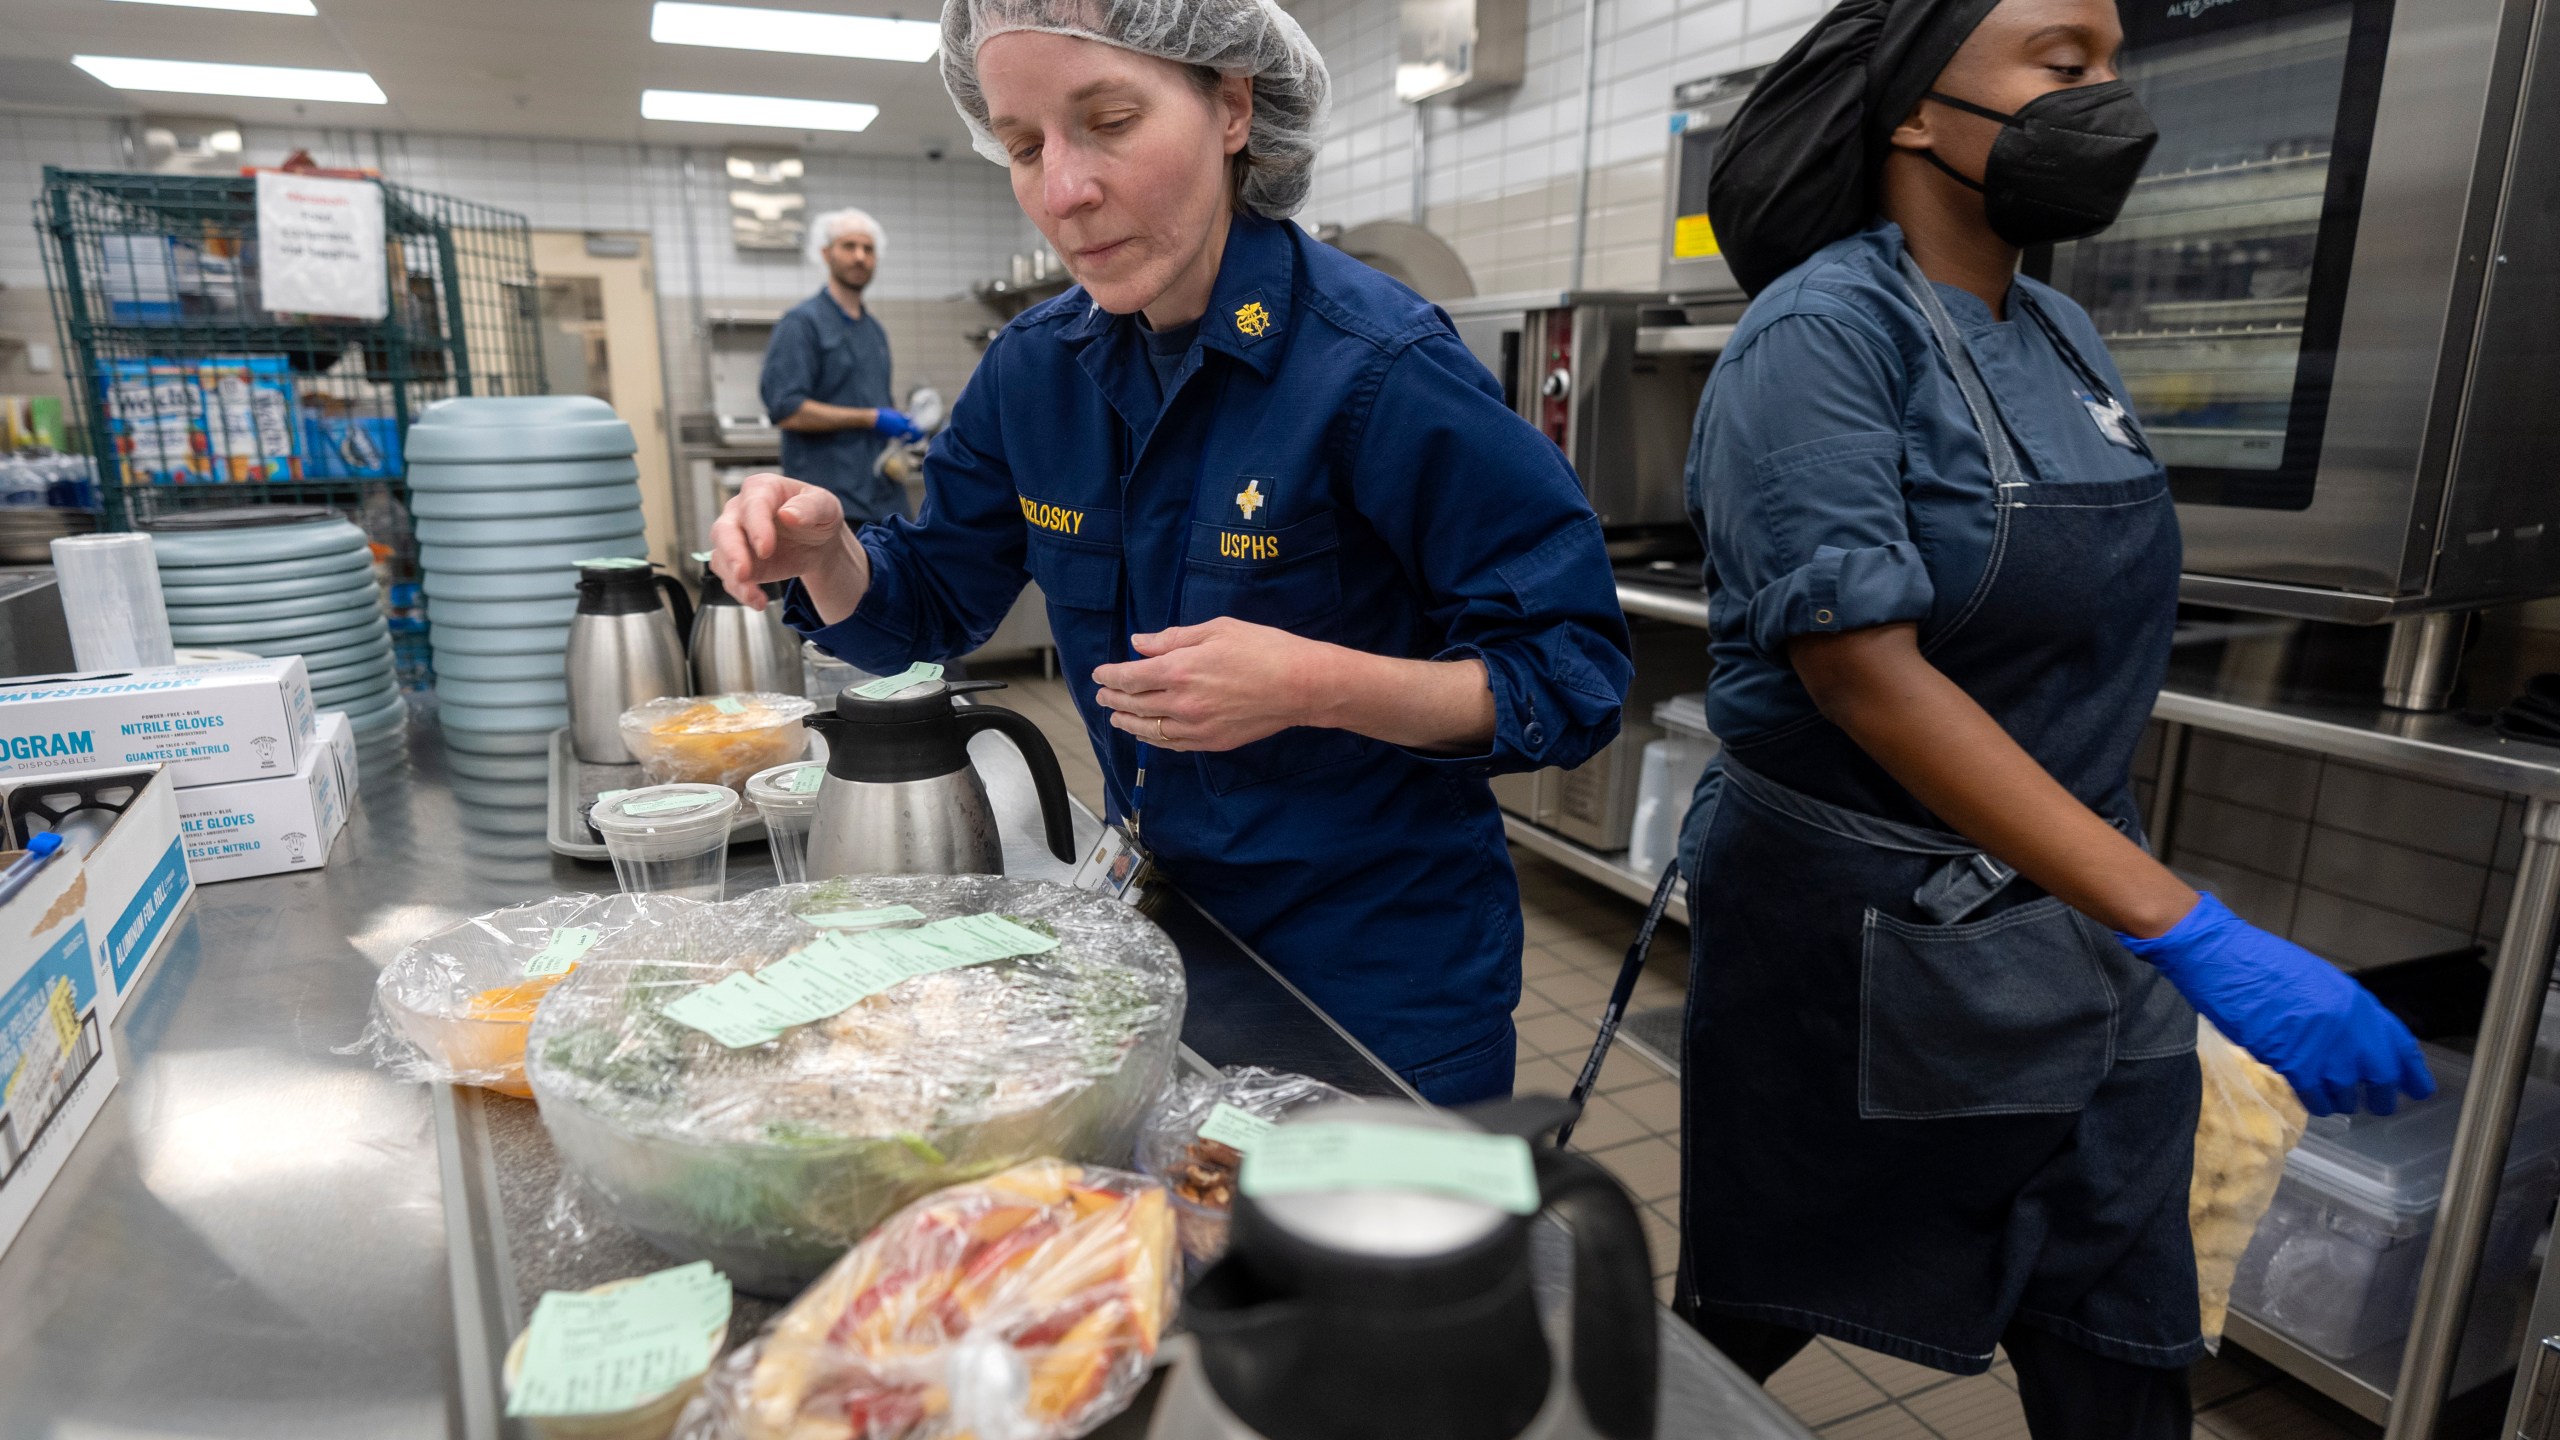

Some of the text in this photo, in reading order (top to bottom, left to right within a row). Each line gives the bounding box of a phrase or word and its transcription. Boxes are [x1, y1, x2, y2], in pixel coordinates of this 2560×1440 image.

[1221, 532, 1280, 560] USPHS
[141, 711, 180, 720] POWDER-FREE
[120, 715, 225, 736] NITRILE GLOVES
[125, 749, 173, 763] GUANTES
[176, 747, 188, 757] DE
[191, 743, 230, 756] NITRILO
[17, 755, 96, 770] DISPOSABLES
[207, 813, 255, 829] GLOVES
[207, 845, 220, 856] DE
[222, 840, 261, 854] NITRILO
[115, 880, 168, 969] ALUMINUM FOIL ROLL
